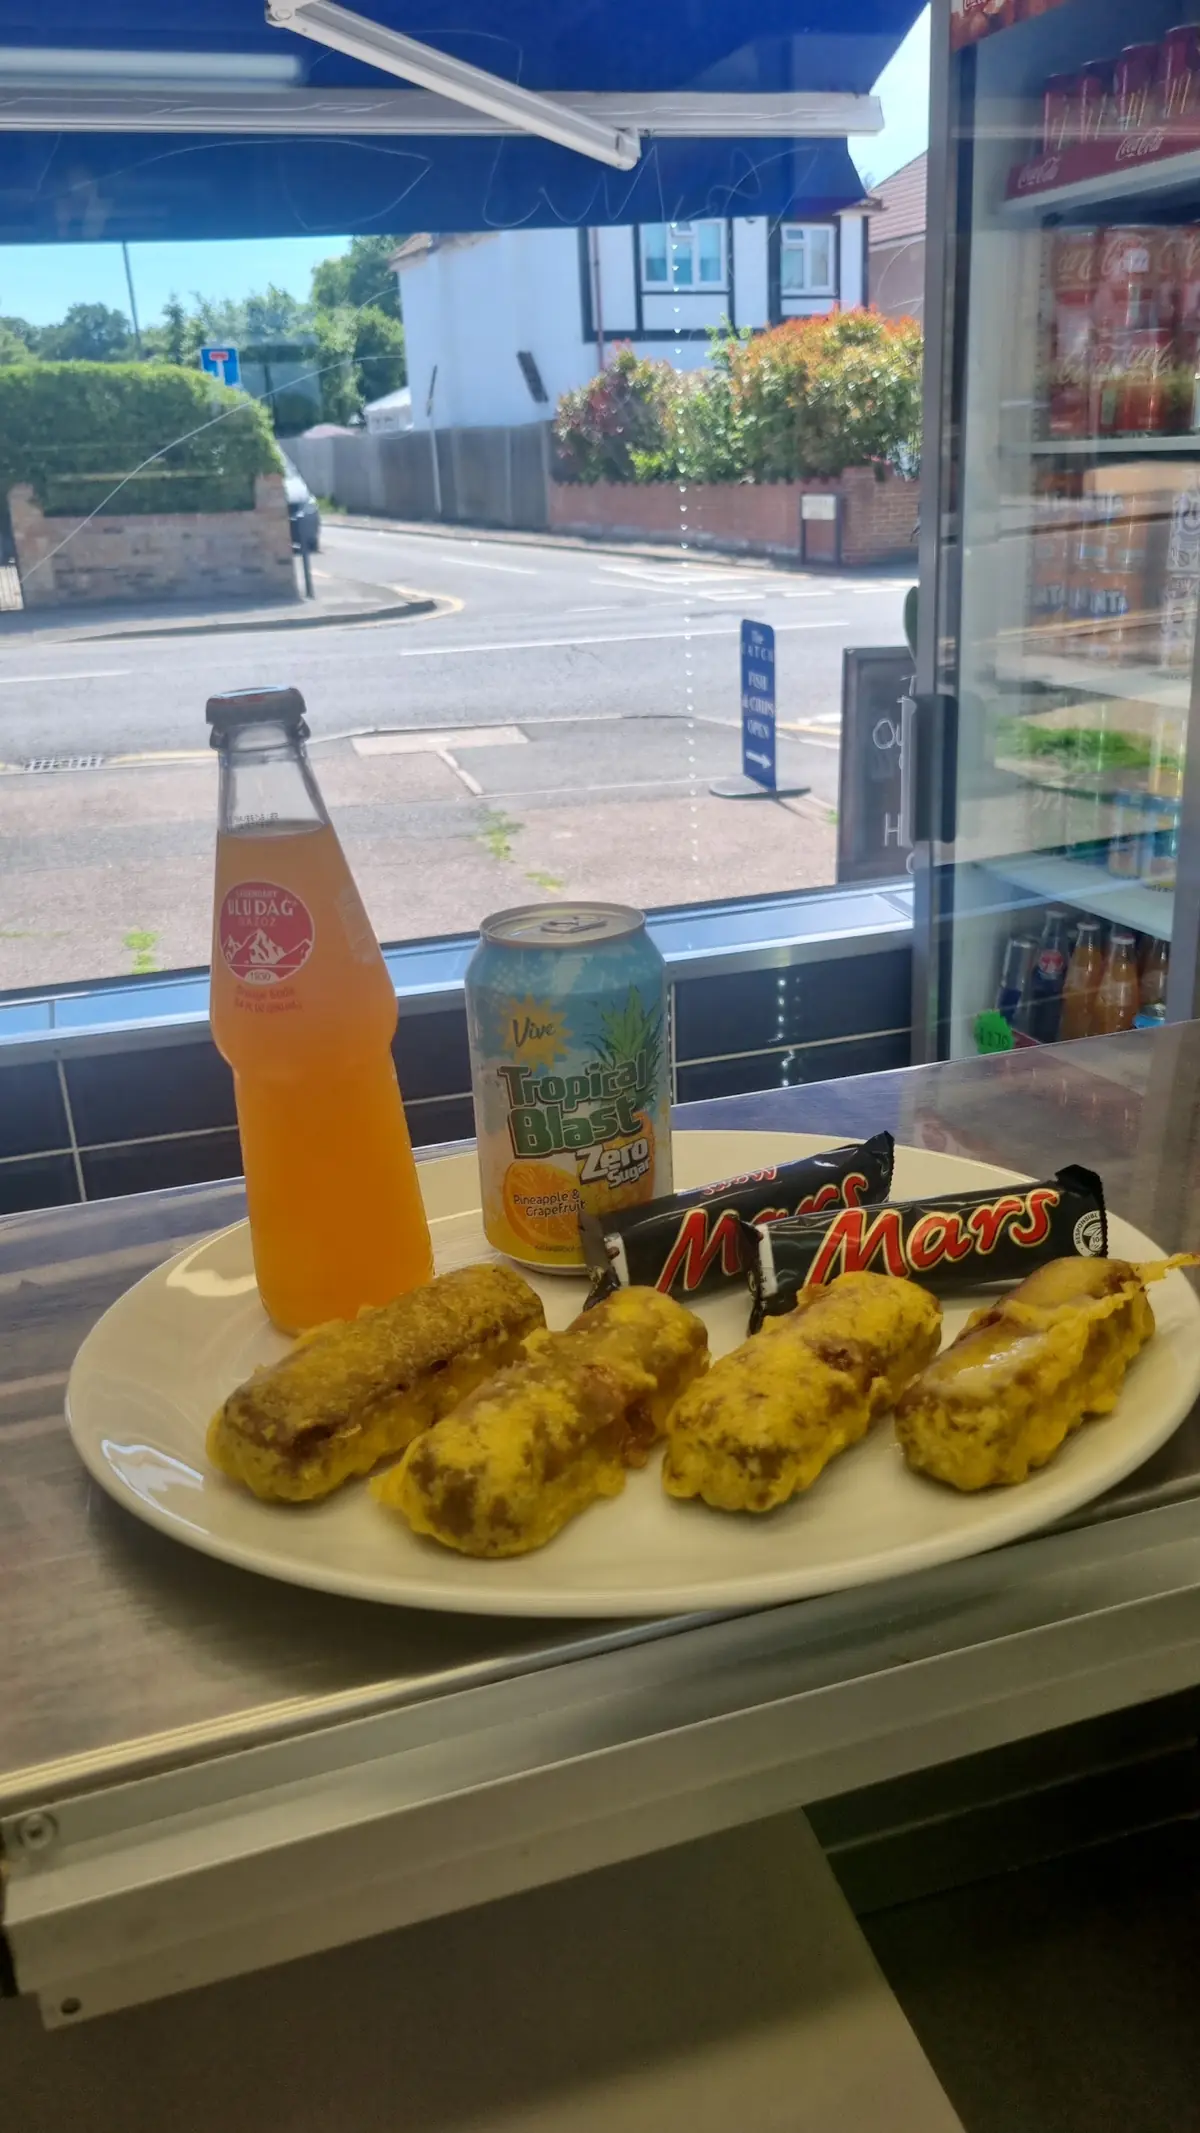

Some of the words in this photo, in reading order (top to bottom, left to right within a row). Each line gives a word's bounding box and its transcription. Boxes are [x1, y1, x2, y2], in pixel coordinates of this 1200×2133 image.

[512, 1016, 556, 1047] Vive
[498, 1052, 648, 1113] Tropical
[509, 1098, 643, 1158] Blast
[576, 1138, 649, 1184] Zero
[606, 1159, 651, 1188] Sugar
[513, 1192, 569, 1205] Pineapple
[572, 1189, 580, 1199] &
[526, 1200, 586, 1217] Grapefruit
[803, 1188, 1060, 1287] Mars
